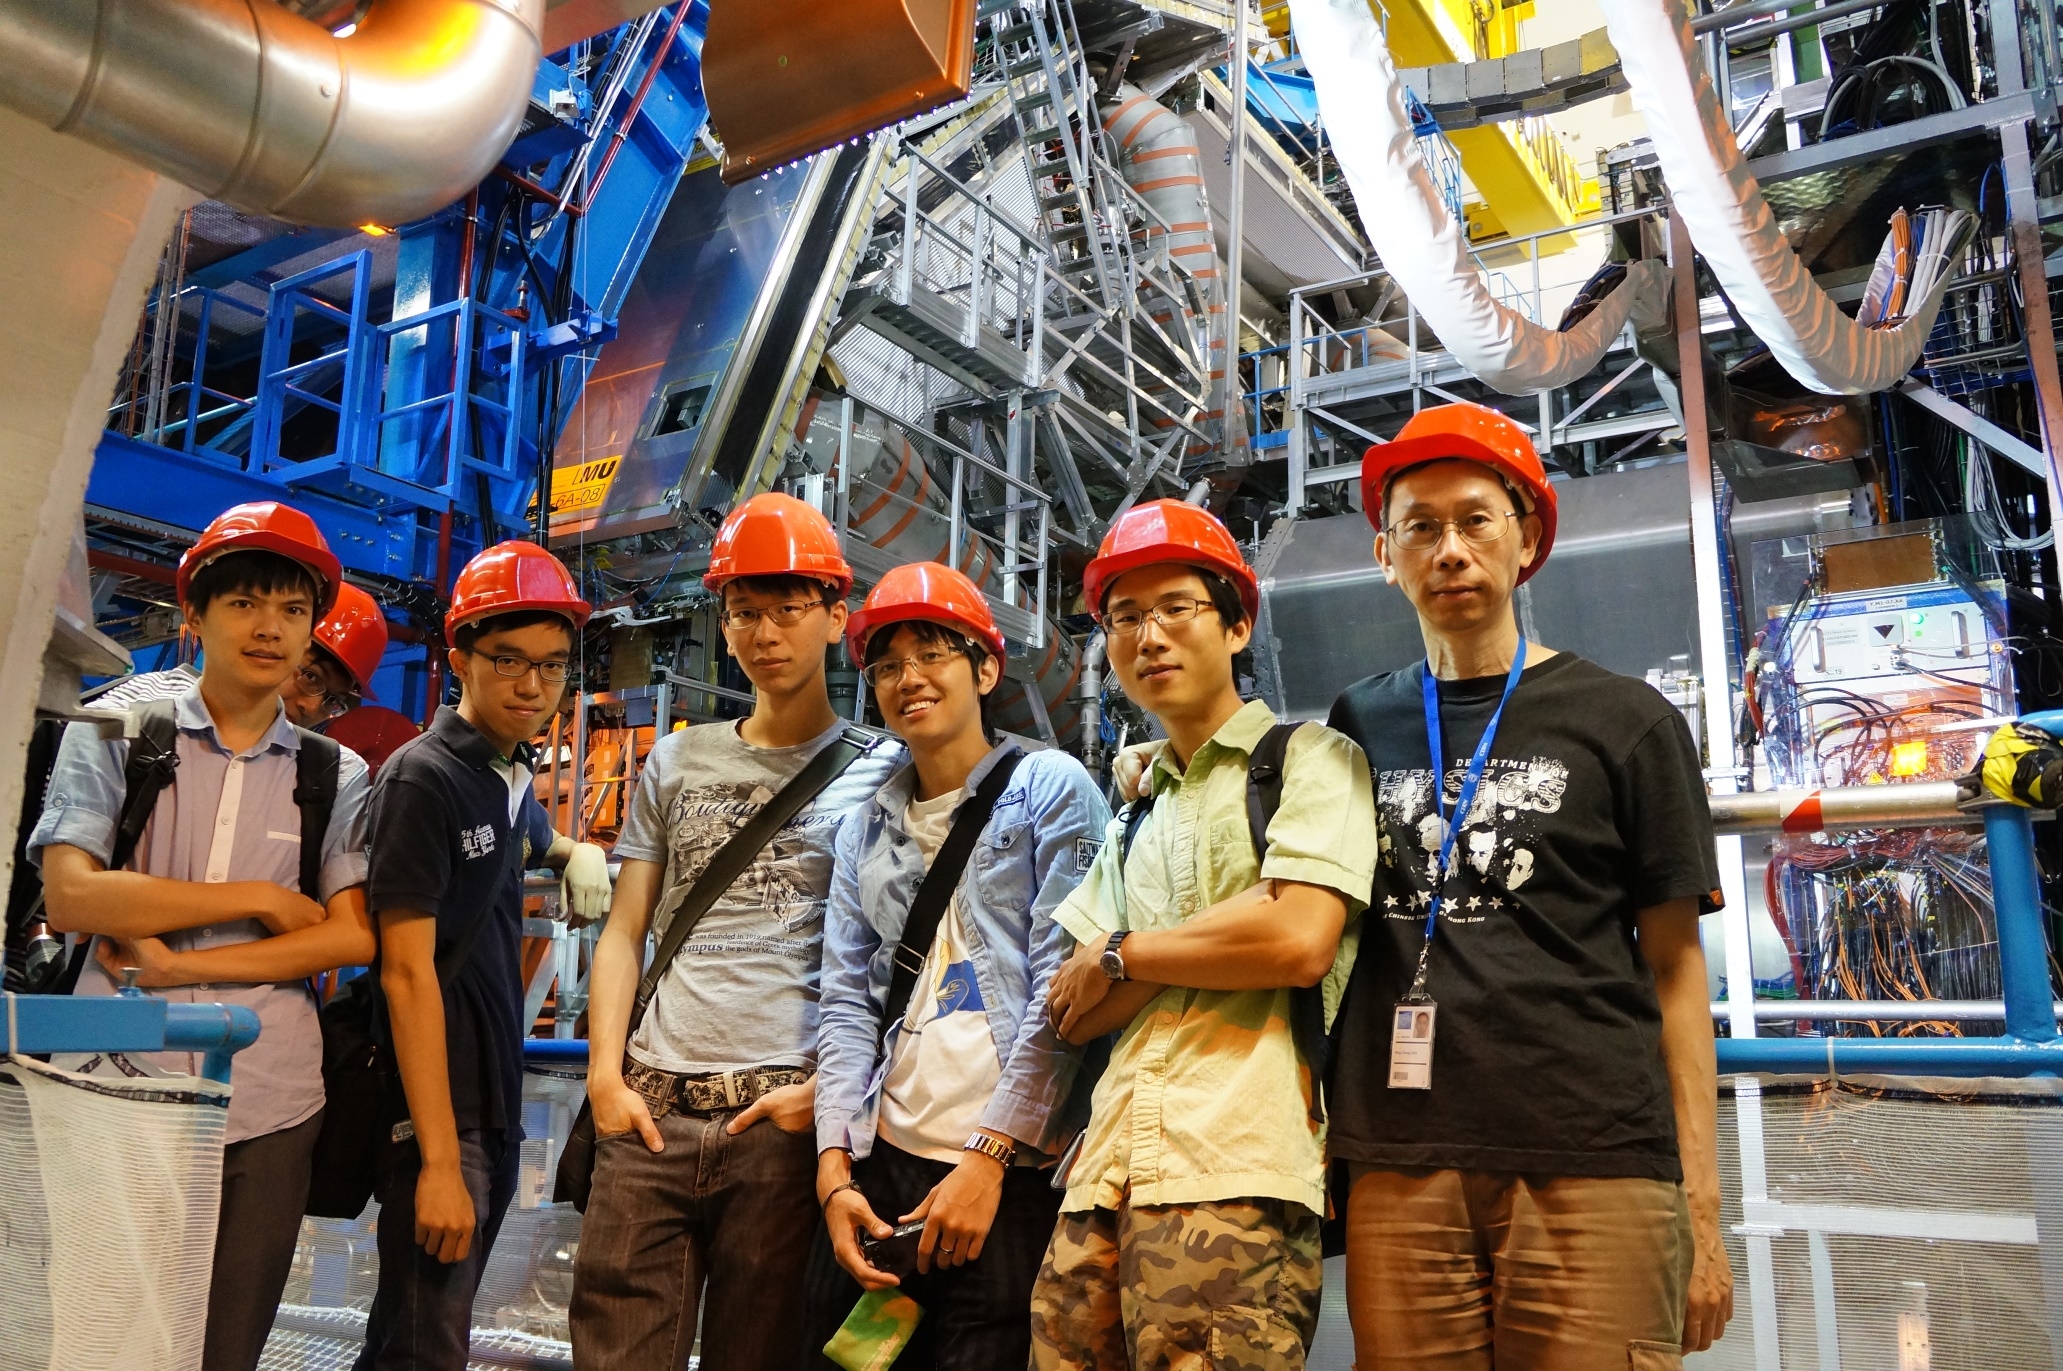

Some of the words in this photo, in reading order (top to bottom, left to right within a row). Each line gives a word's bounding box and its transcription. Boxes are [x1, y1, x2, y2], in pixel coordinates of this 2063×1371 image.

[1479, 742, 1488, 757] CERN
[1456, 758, 1546, 772] DEARTMEN
[1371, 767, 1567, 814] HYSICS
[666, 792, 765, 830] Boutiqu
[461, 828, 496, 852] HILFIGER
[762, 941, 780, 949] Greek
[787, 938, 801, 946] after
[677, 943, 723, 956] lympus
[761, 947, 783, 956] Mount
[784, 951, 809, 961] Olympus
